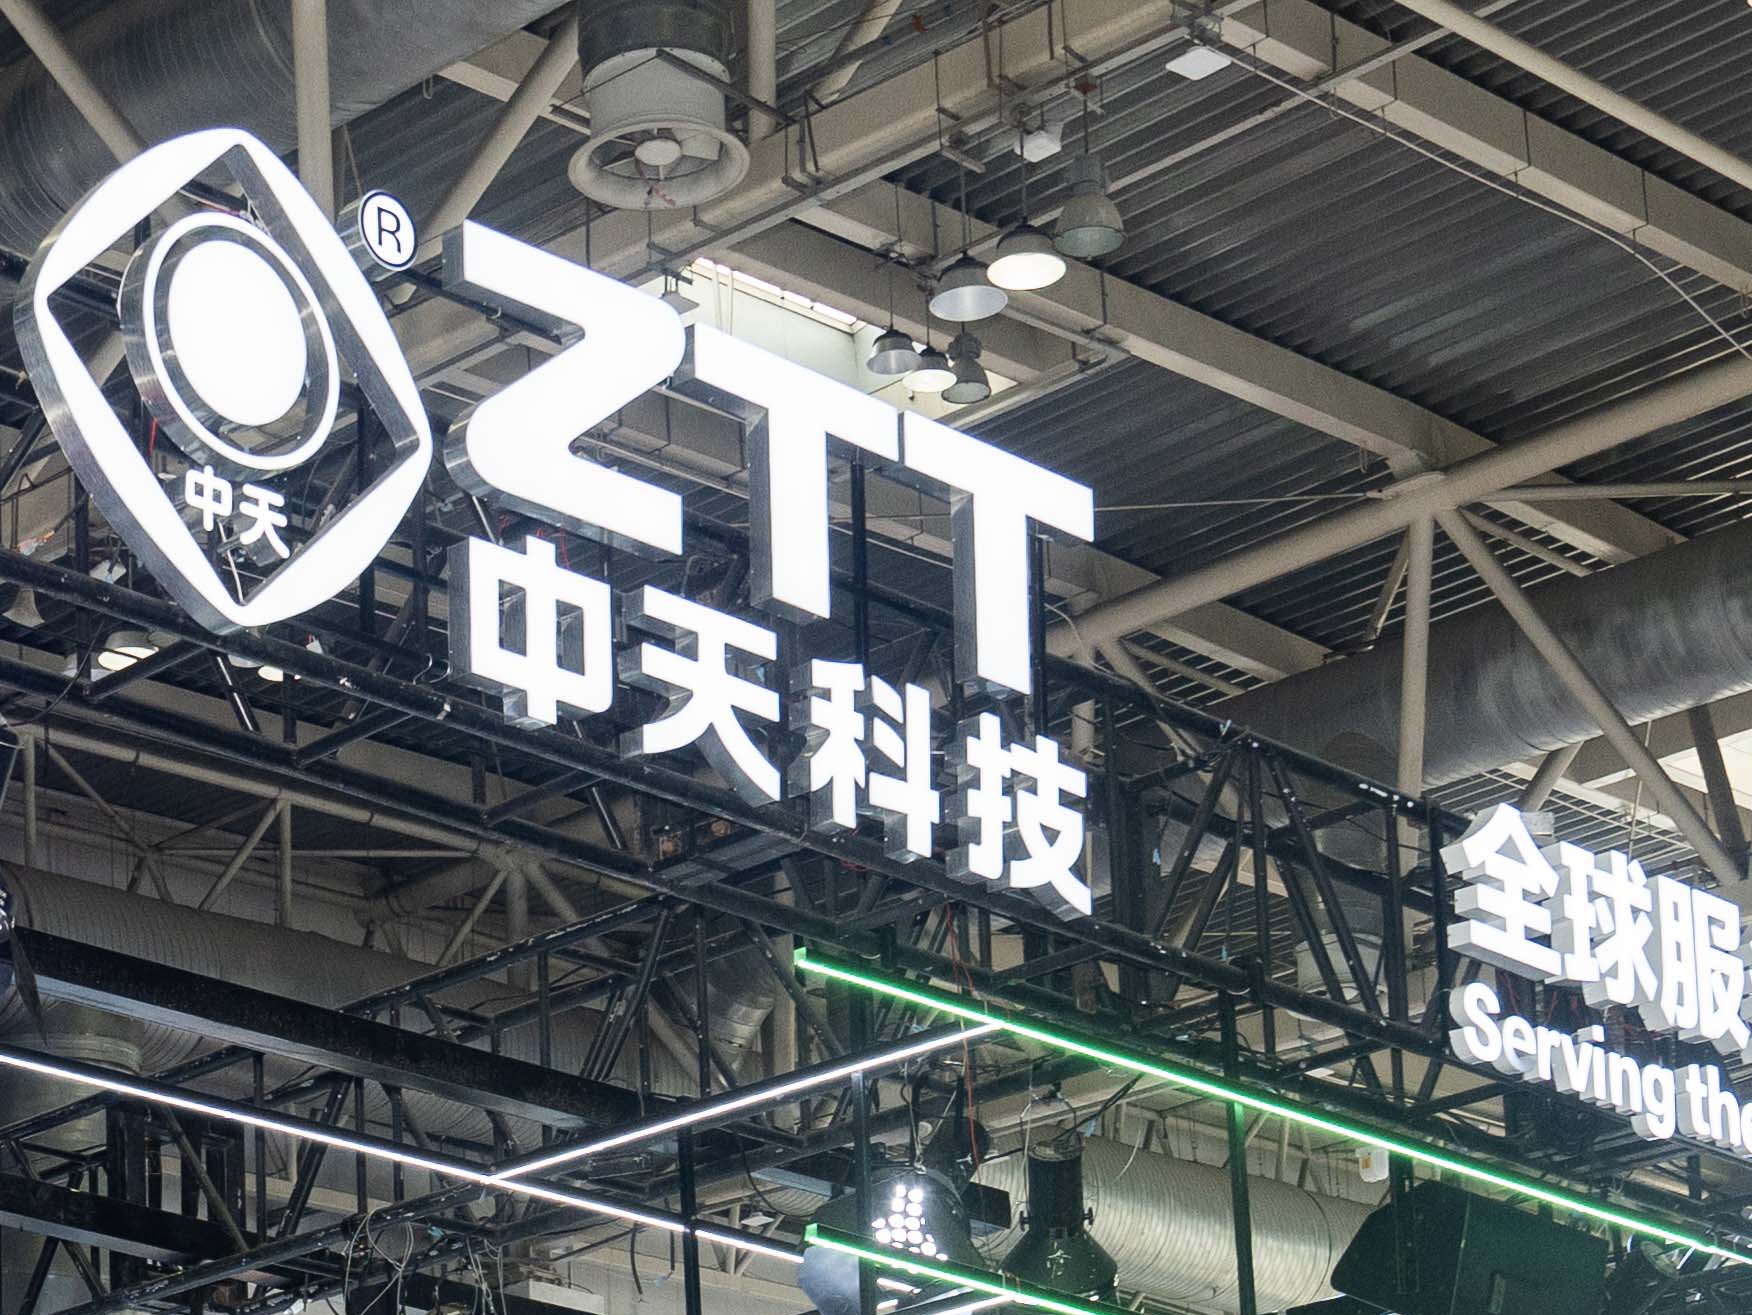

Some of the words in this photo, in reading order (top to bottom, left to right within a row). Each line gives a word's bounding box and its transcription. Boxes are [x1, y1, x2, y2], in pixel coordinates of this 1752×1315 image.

[184, 463, 290, 561] 中天
[451, 217, 1095, 696] ZTT
[461, 535, 1093, 917] 中天科技
[1454, 981, 1677, 1130] Serving
